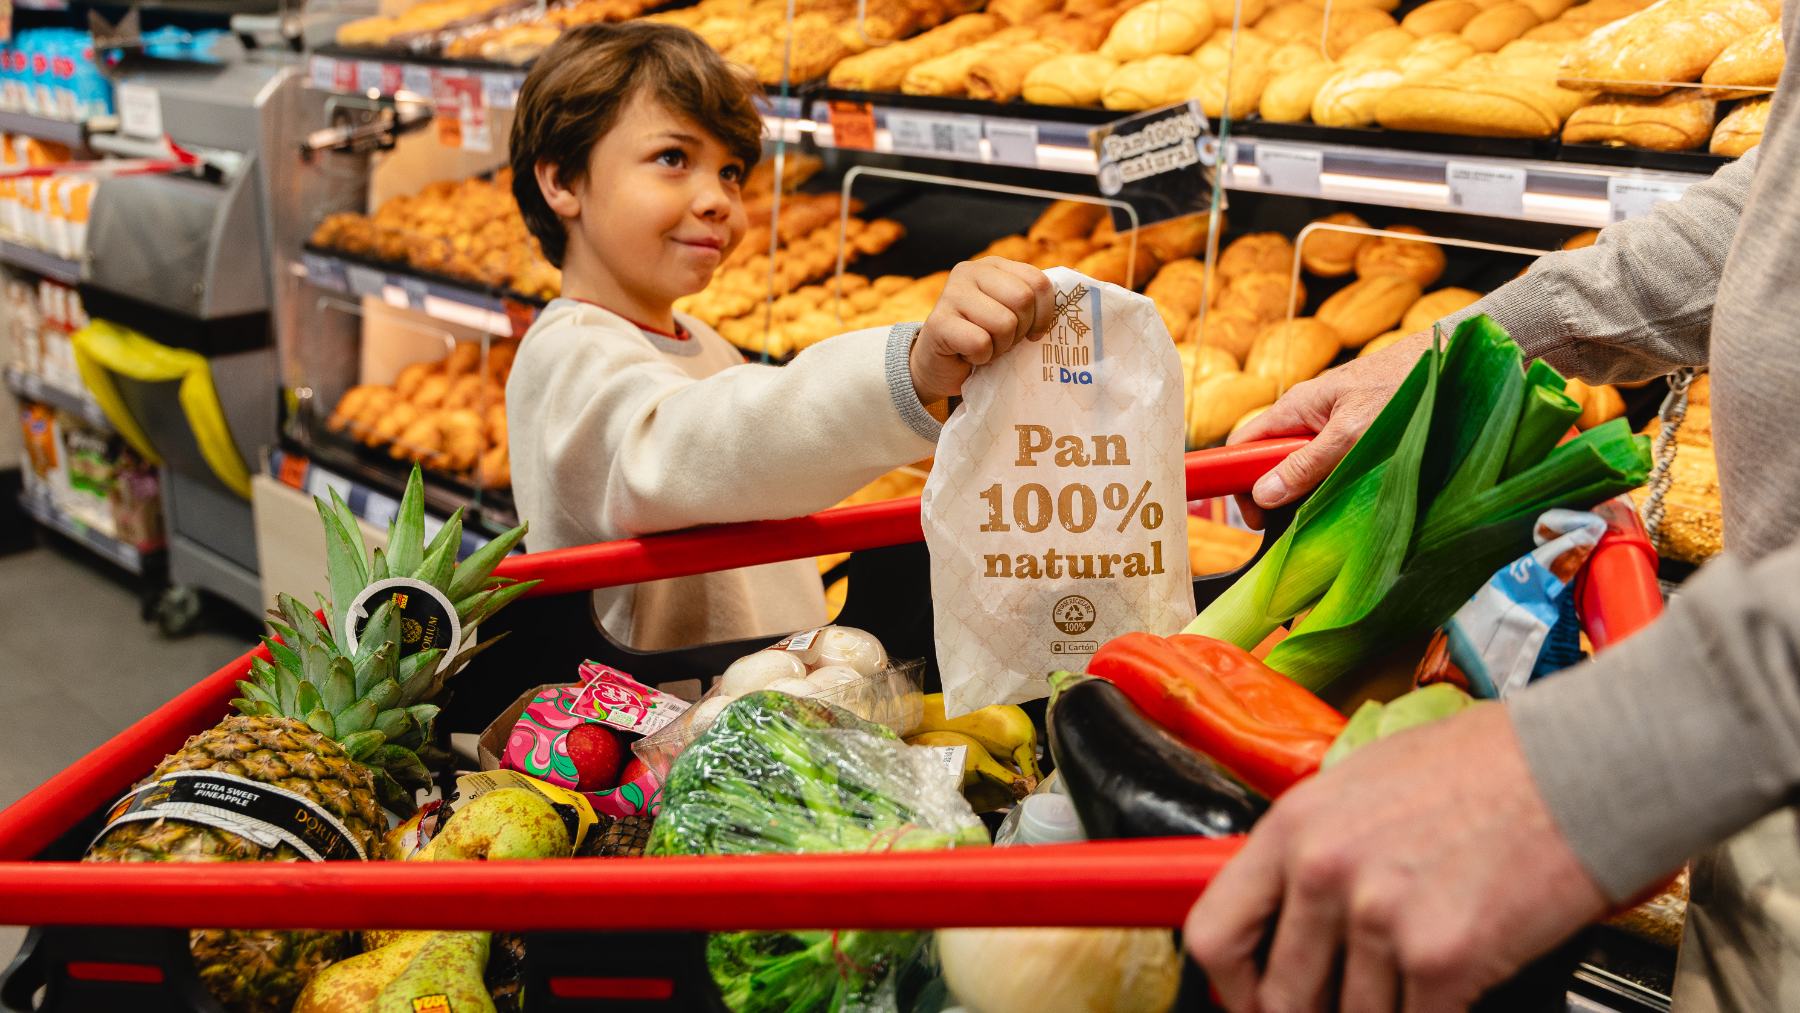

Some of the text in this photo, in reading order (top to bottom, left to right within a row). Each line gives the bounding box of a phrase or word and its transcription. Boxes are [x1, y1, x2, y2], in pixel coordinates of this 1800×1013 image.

[1106, 115, 1199, 160] Pan 100%
[1121, 141, 1198, 180] natural
[1057, 325, 1070, 346] EL
[1042, 343, 1089, 368] MOLINO
[1042, 366, 1055, 382] DE
[1014, 424, 1131, 468] Pan
[979, 480, 1164, 534] 100%
[983, 540, 1166, 580] natural
[1064, 622, 1086, 632] 100%
[1068, 643, 1094, 651] Cartón
[193, 782, 260, 801] EXTRA SWEET
[194, 789, 250, 807] PINEAPPLE
